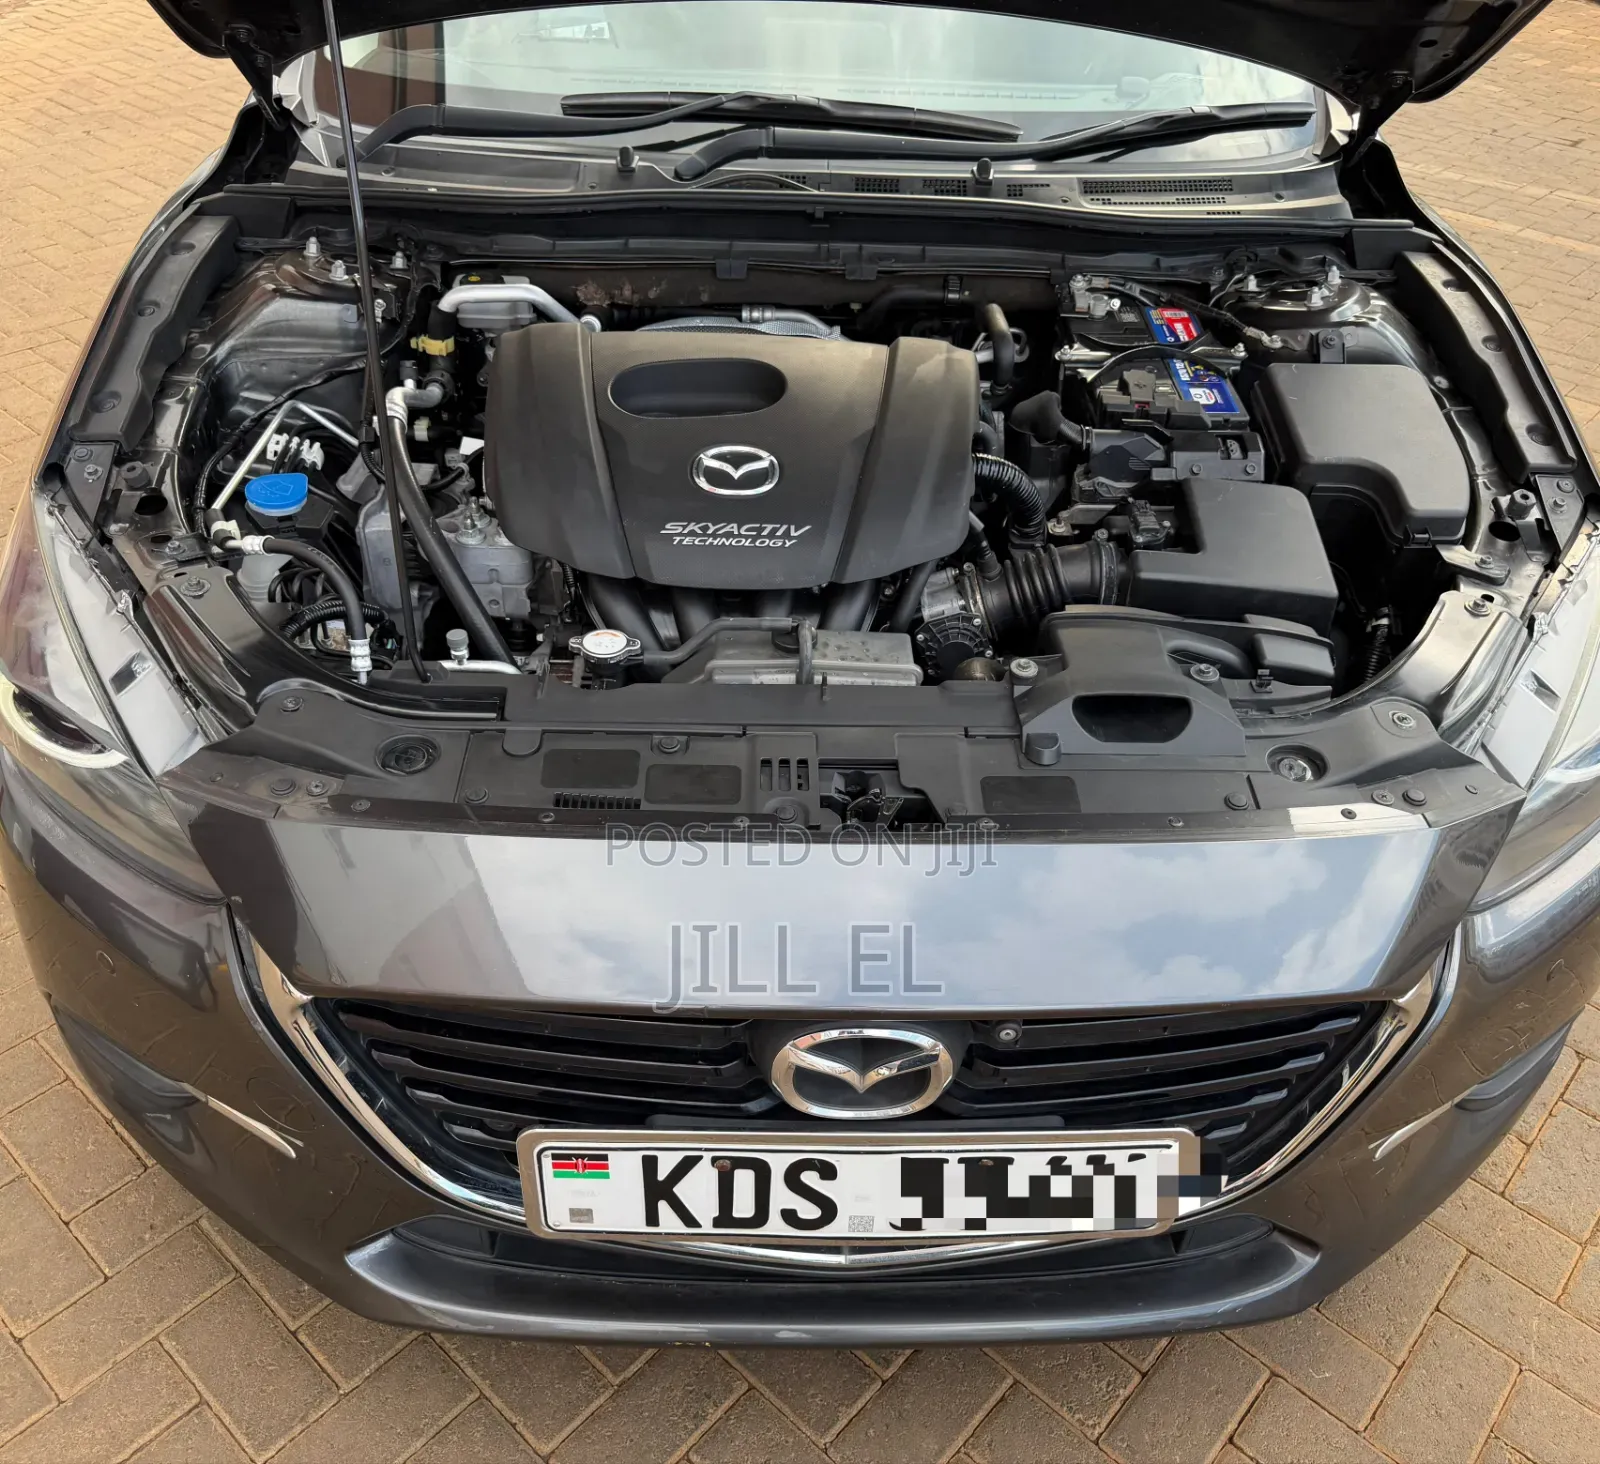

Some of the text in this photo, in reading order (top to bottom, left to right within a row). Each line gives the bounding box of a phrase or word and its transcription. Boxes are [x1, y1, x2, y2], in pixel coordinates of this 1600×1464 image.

[659, 521, 812, 537] SKYACTIV
[672, 536, 798, 548] TECHNOLOGY
[641, 1154, 839, 1230] KDS
